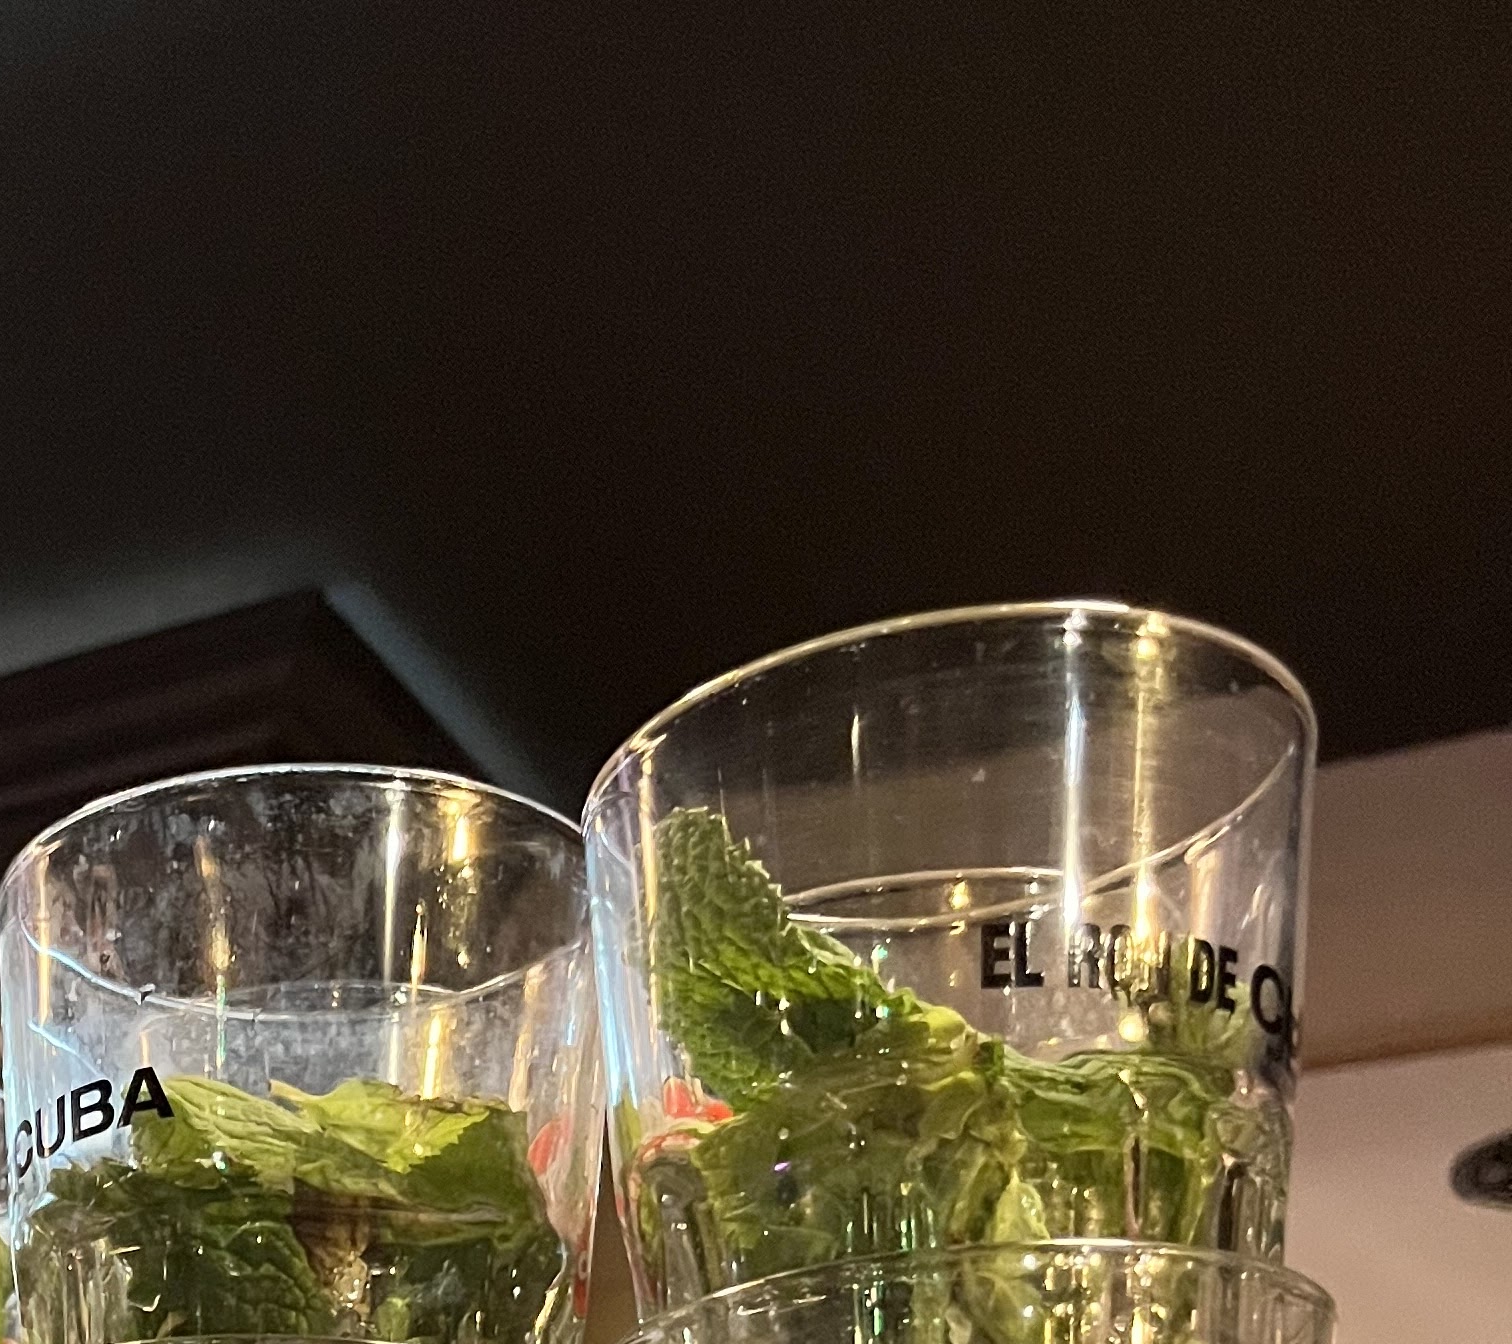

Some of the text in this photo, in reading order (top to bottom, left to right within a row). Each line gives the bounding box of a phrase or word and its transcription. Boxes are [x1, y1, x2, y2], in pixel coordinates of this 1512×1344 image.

[981, 922, 1044, 990] EL
[1188, 937, 1238, 1016] DE
[14, 1066, 175, 1179] CUBA
